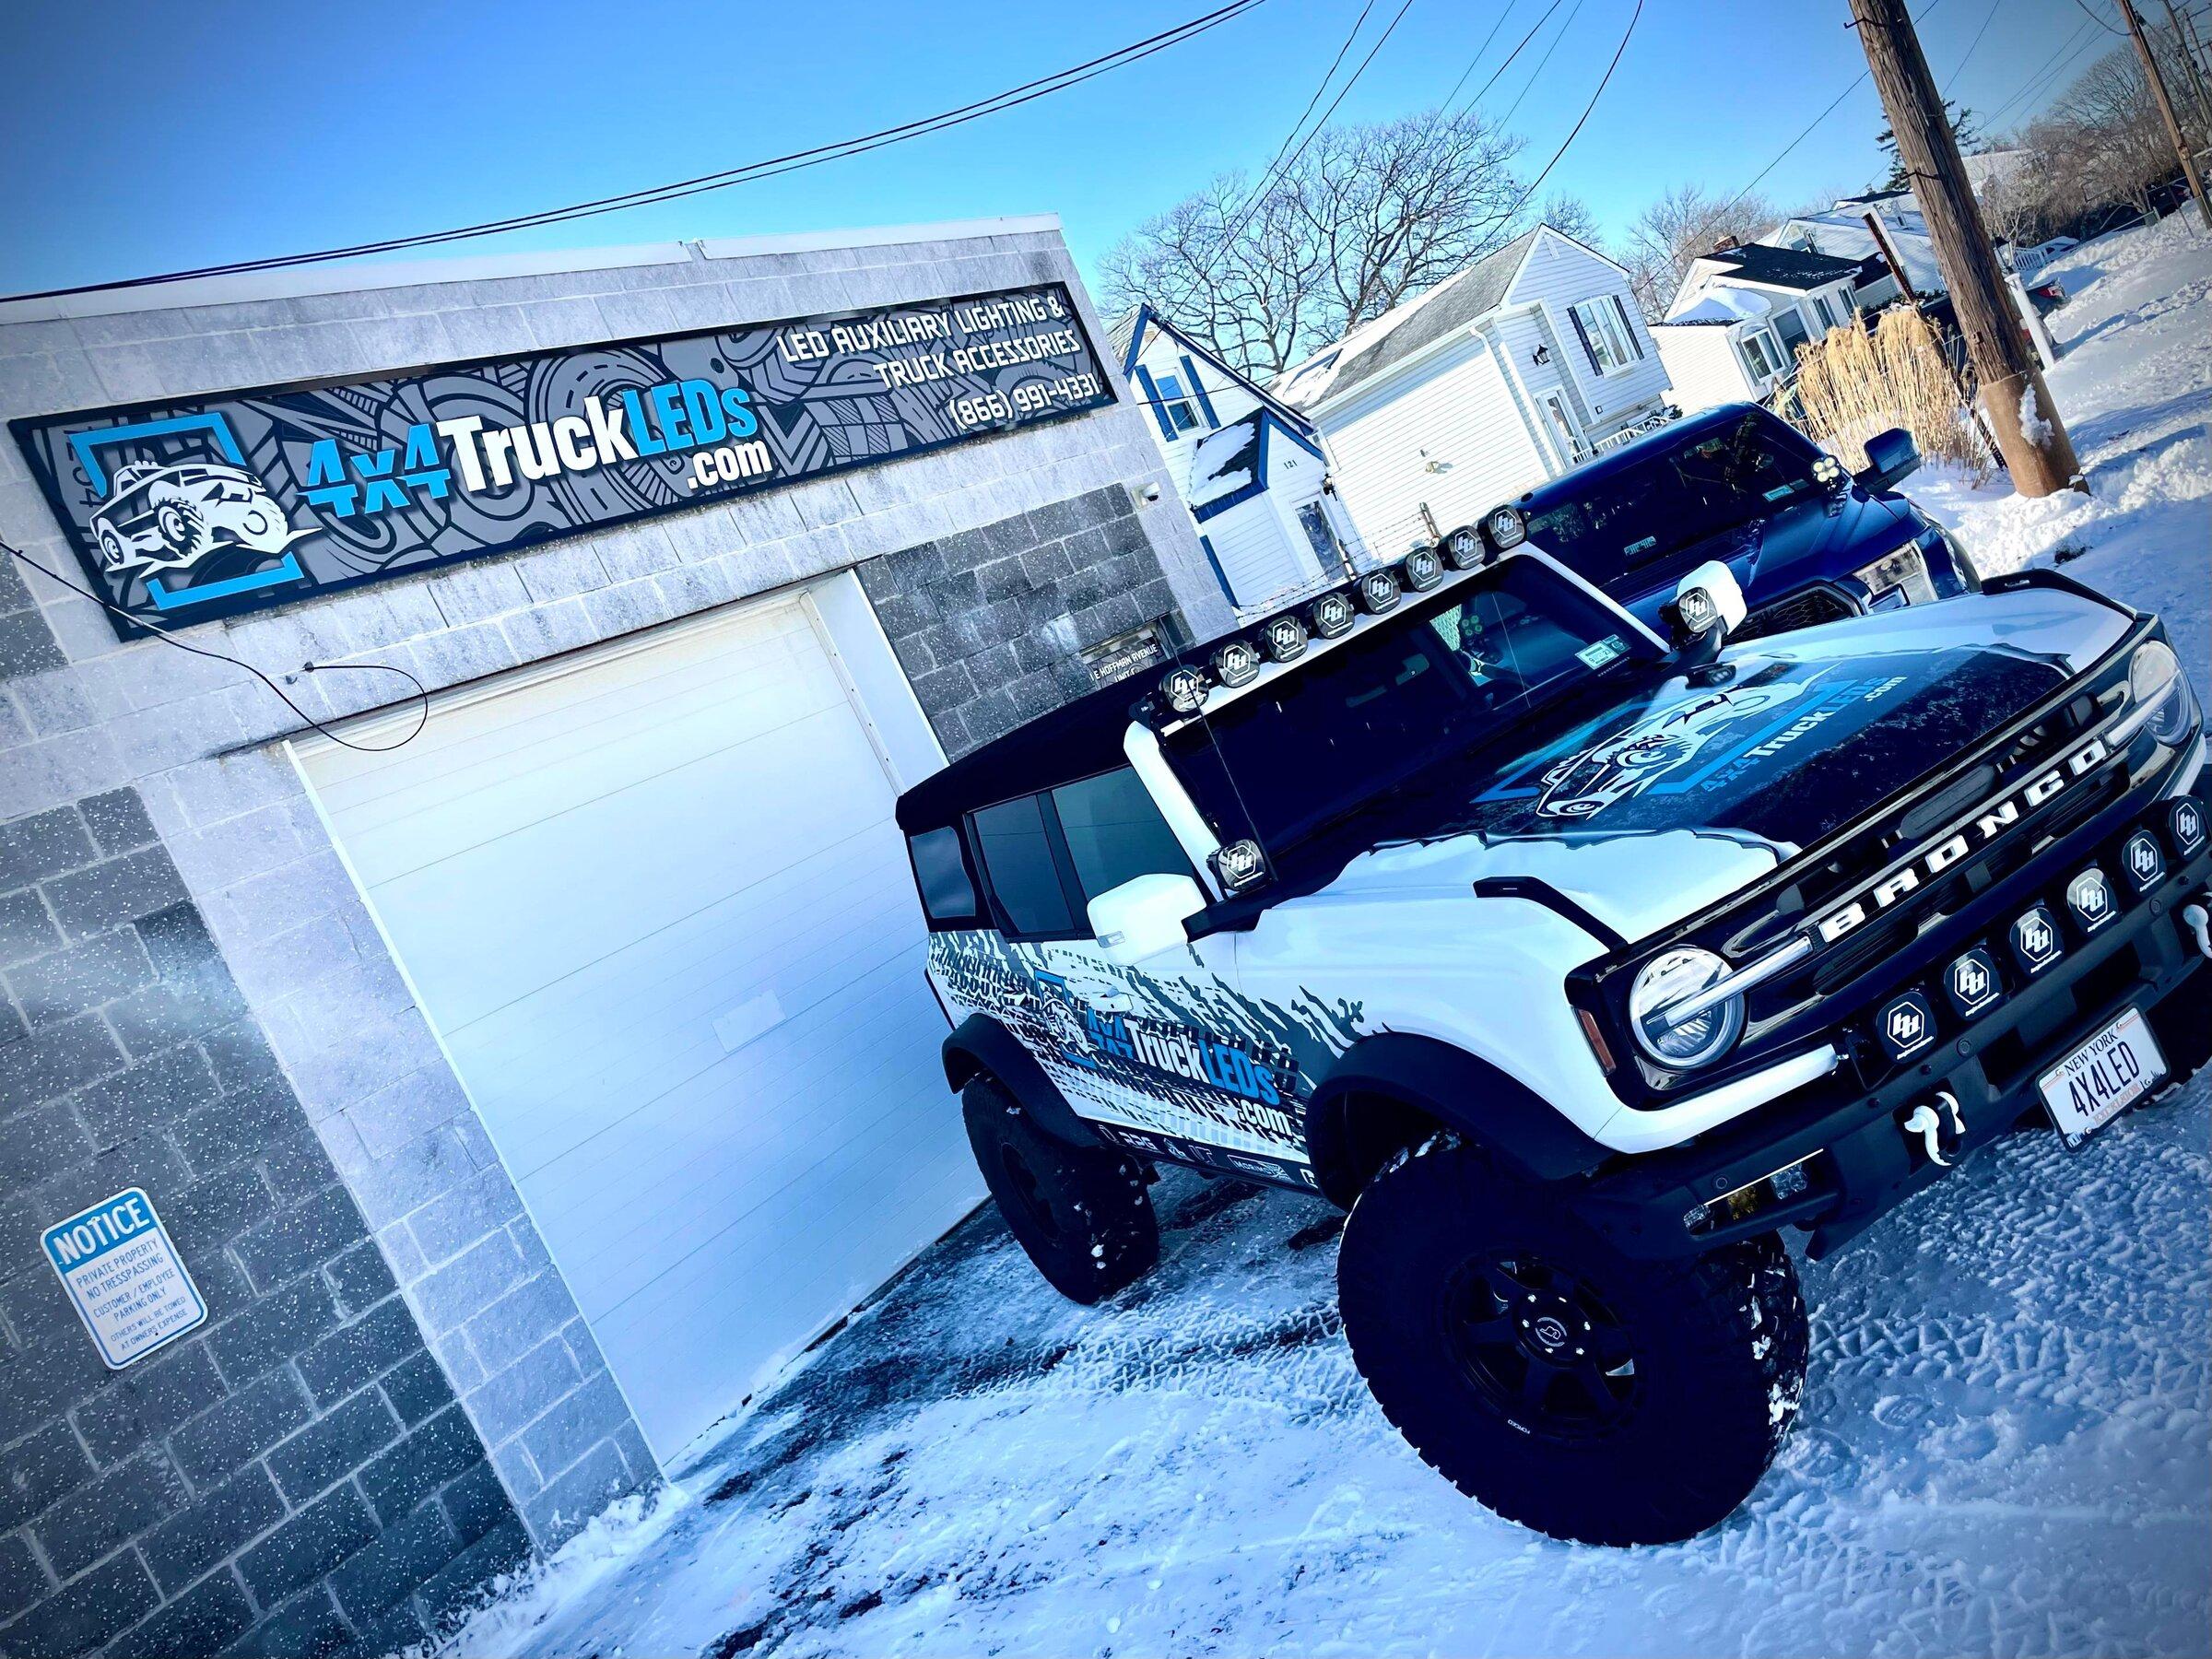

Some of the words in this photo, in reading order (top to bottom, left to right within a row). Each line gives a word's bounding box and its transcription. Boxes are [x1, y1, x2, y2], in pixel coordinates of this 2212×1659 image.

[777, 333, 830, 363] LED
[834, 310, 951, 355] AUXILIARY
[958, 301, 1048, 333] LIGHTING
[1048, 296, 1065, 319] &
[873, 352, 951, 391] TRUCK
[955, 329, 1081, 372] ACCESSORIES
[948, 393, 1015, 431] (866)
[1013, 372, 1103, 413] 991-4331
[686, 439, 772, 489] .com
[1283, 460, 1298, 469] 121
[1094, 670, 1100, 680] E
[1100, 655, 1133, 677] HOFFMAN
[1132, 643, 1159, 665] AVENUE
[1114, 670, 1131, 682] UNIT
[1864, 676, 1908, 702] .com
[1818, 741, 2108, 943] BRONCO
[2064, 1049, 2089, 1077] NEW
[2088, 1029, 2119, 1057] YORK
[2068, 1041, 2140, 1117] 4X4LED
[1238, 1100, 1291, 1136] .com
[53, 1197, 150, 1265] NOTICE
[76, 1262, 114, 1288] PRIVATE
[114, 1239, 159, 1269] PROPERTY
[87, 1284, 101, 1300] NO
[100, 1253, 165, 1293] TRESSPASSING
[93, 1291, 133, 1318] CUSTOMER
[138, 1268, 176, 1294] EMPLOYEE
[113, 1299, 147, 1322] PARKING
[147, 1288, 167, 1304] ONLY
[111, 1324, 137, 1342] OTHERS
[137, 1313, 154, 1328] WILL
[153, 1309, 164, 1319] BE
[162, 1296, 187, 1313] TOWED
[121, 1340, 131, 1350] AT
[130, 1325, 158, 1346] OWNERS
[157, 1309, 188, 1330] EXPENSE
